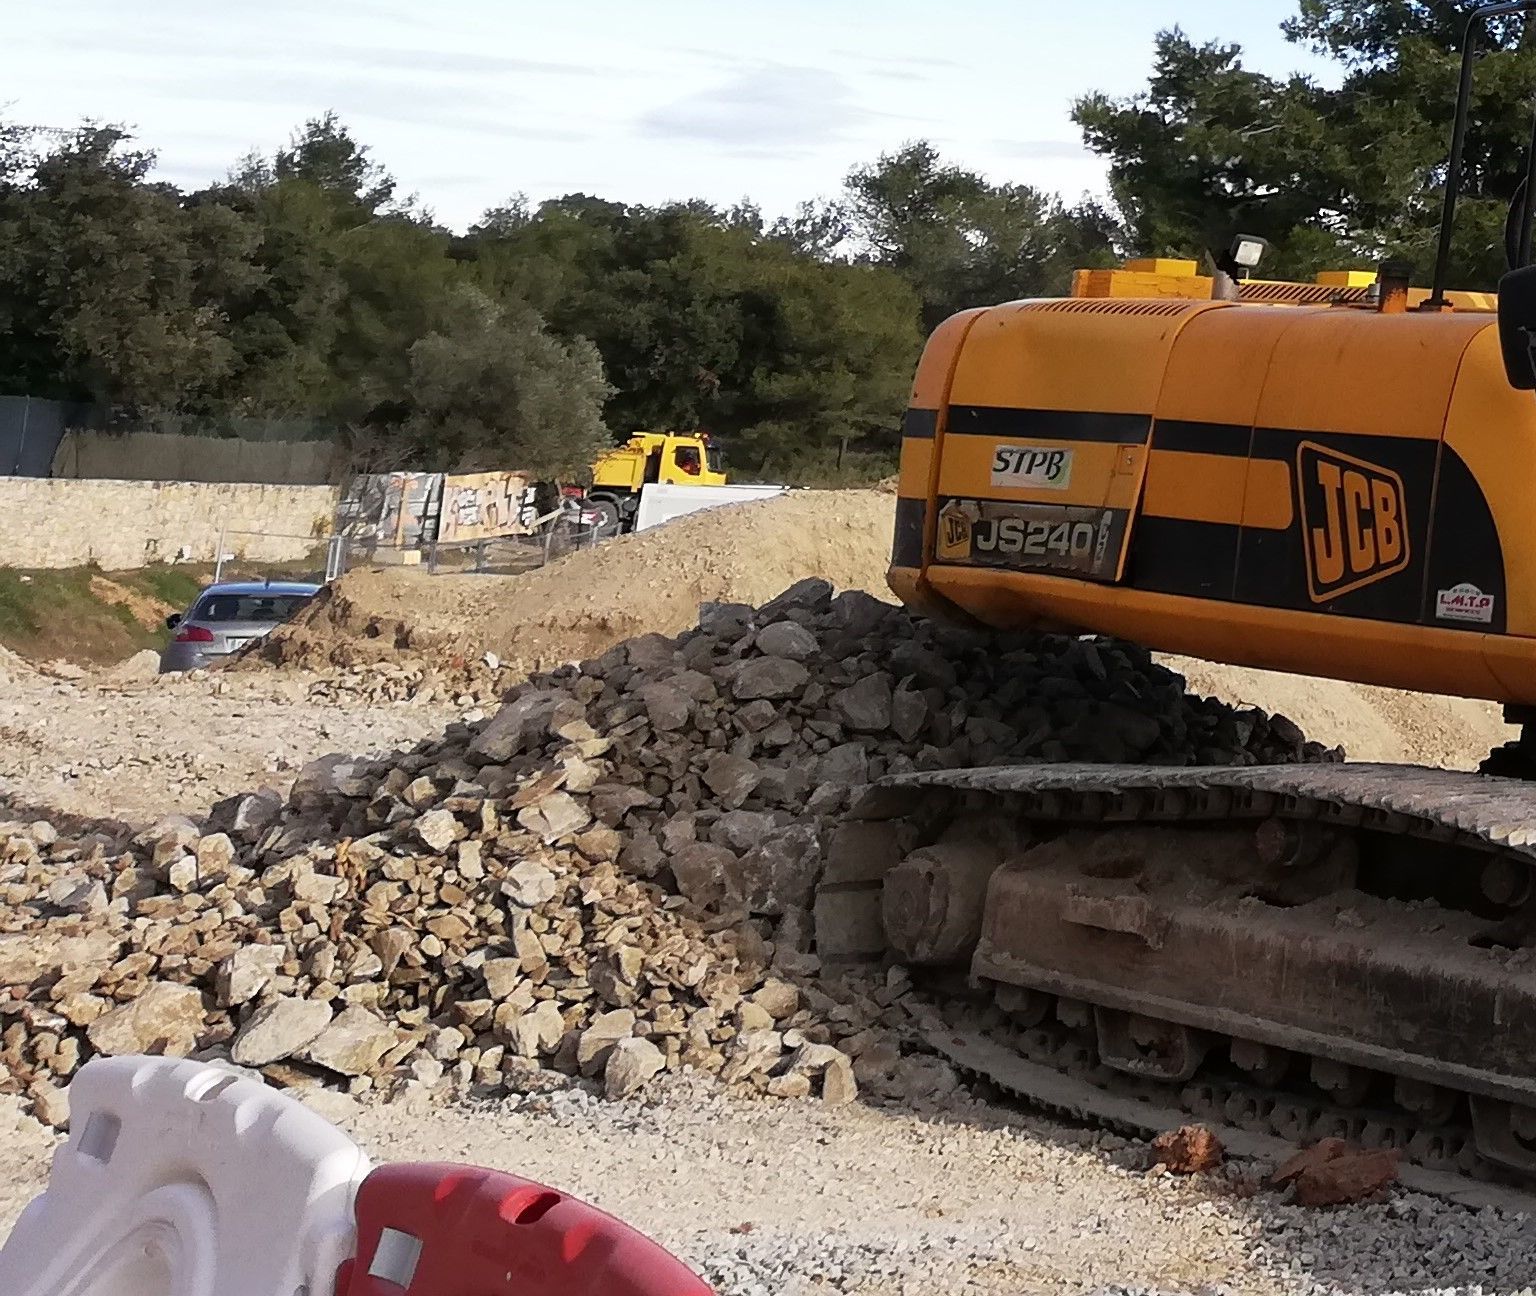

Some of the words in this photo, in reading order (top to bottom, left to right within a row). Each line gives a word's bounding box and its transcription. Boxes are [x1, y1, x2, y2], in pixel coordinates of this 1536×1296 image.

[992, 450, 1065, 480] STPB
[976, 517, 1094, 556] JS240
[1313, 460, 1400, 584] JCB
